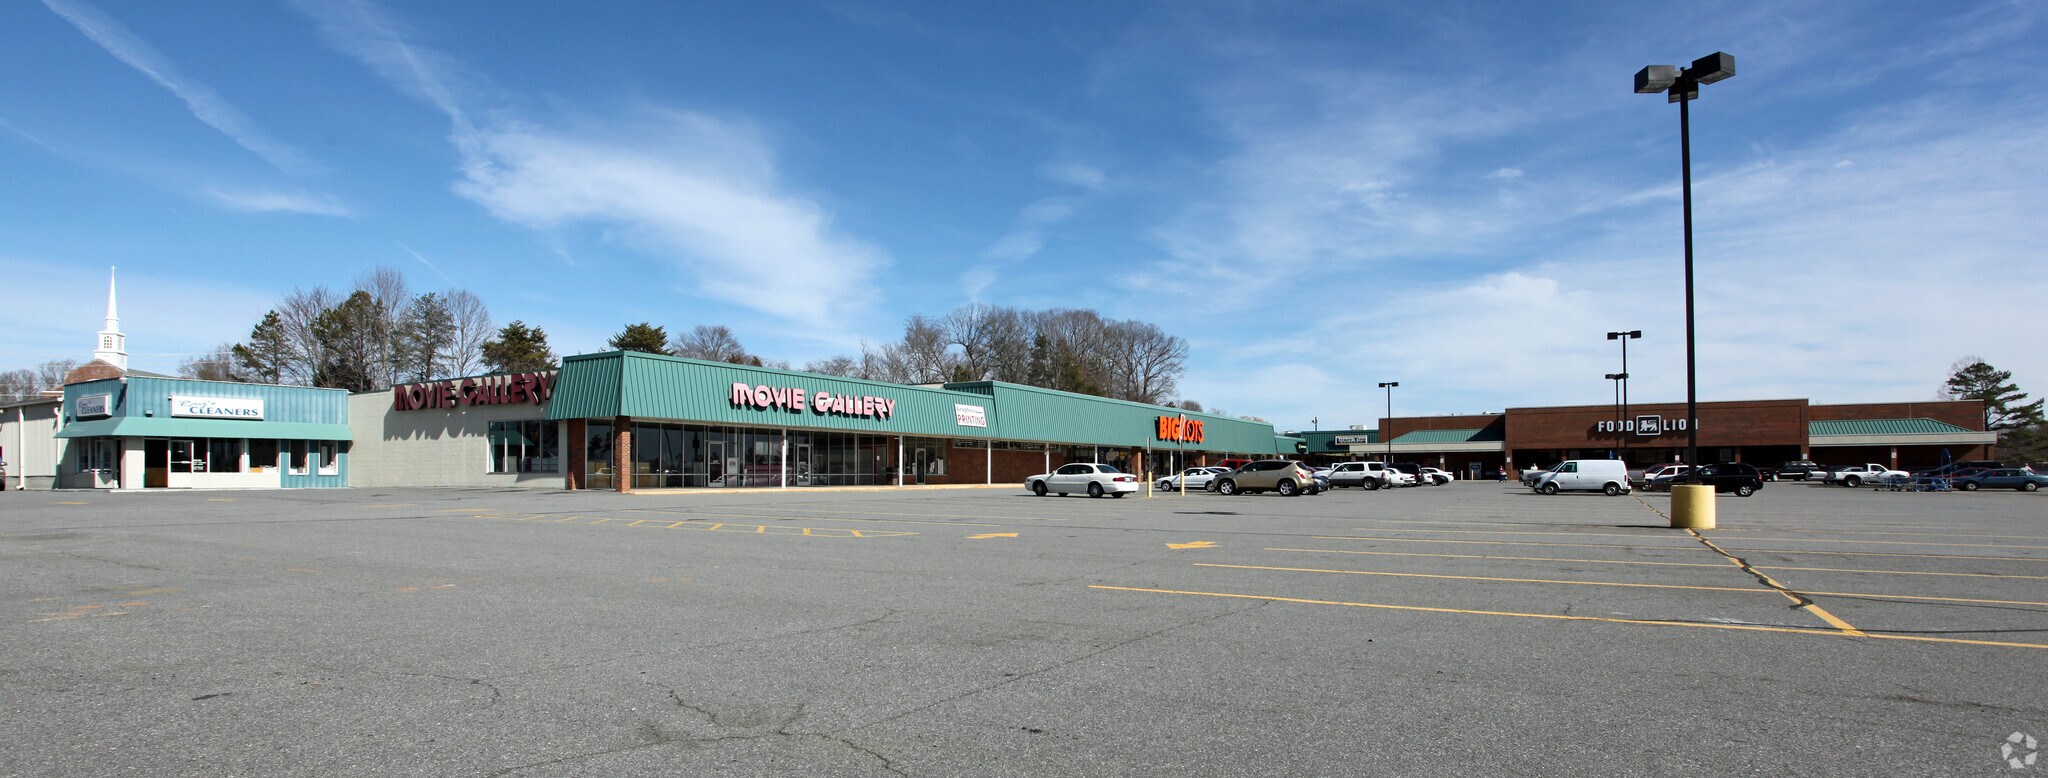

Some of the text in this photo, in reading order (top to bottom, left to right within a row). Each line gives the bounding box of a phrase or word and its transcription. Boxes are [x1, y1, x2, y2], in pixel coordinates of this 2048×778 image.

[394, 370, 552, 411] MOVIE GALLERY
[732, 382, 896, 419] MOVIE GALLERY
[81, 405, 105, 414] CLEANERS
[189, 406, 260, 417] CLEANERS
[957, 414, 986, 426] PRINTING
[1598, 420, 1634, 432] FOOD
